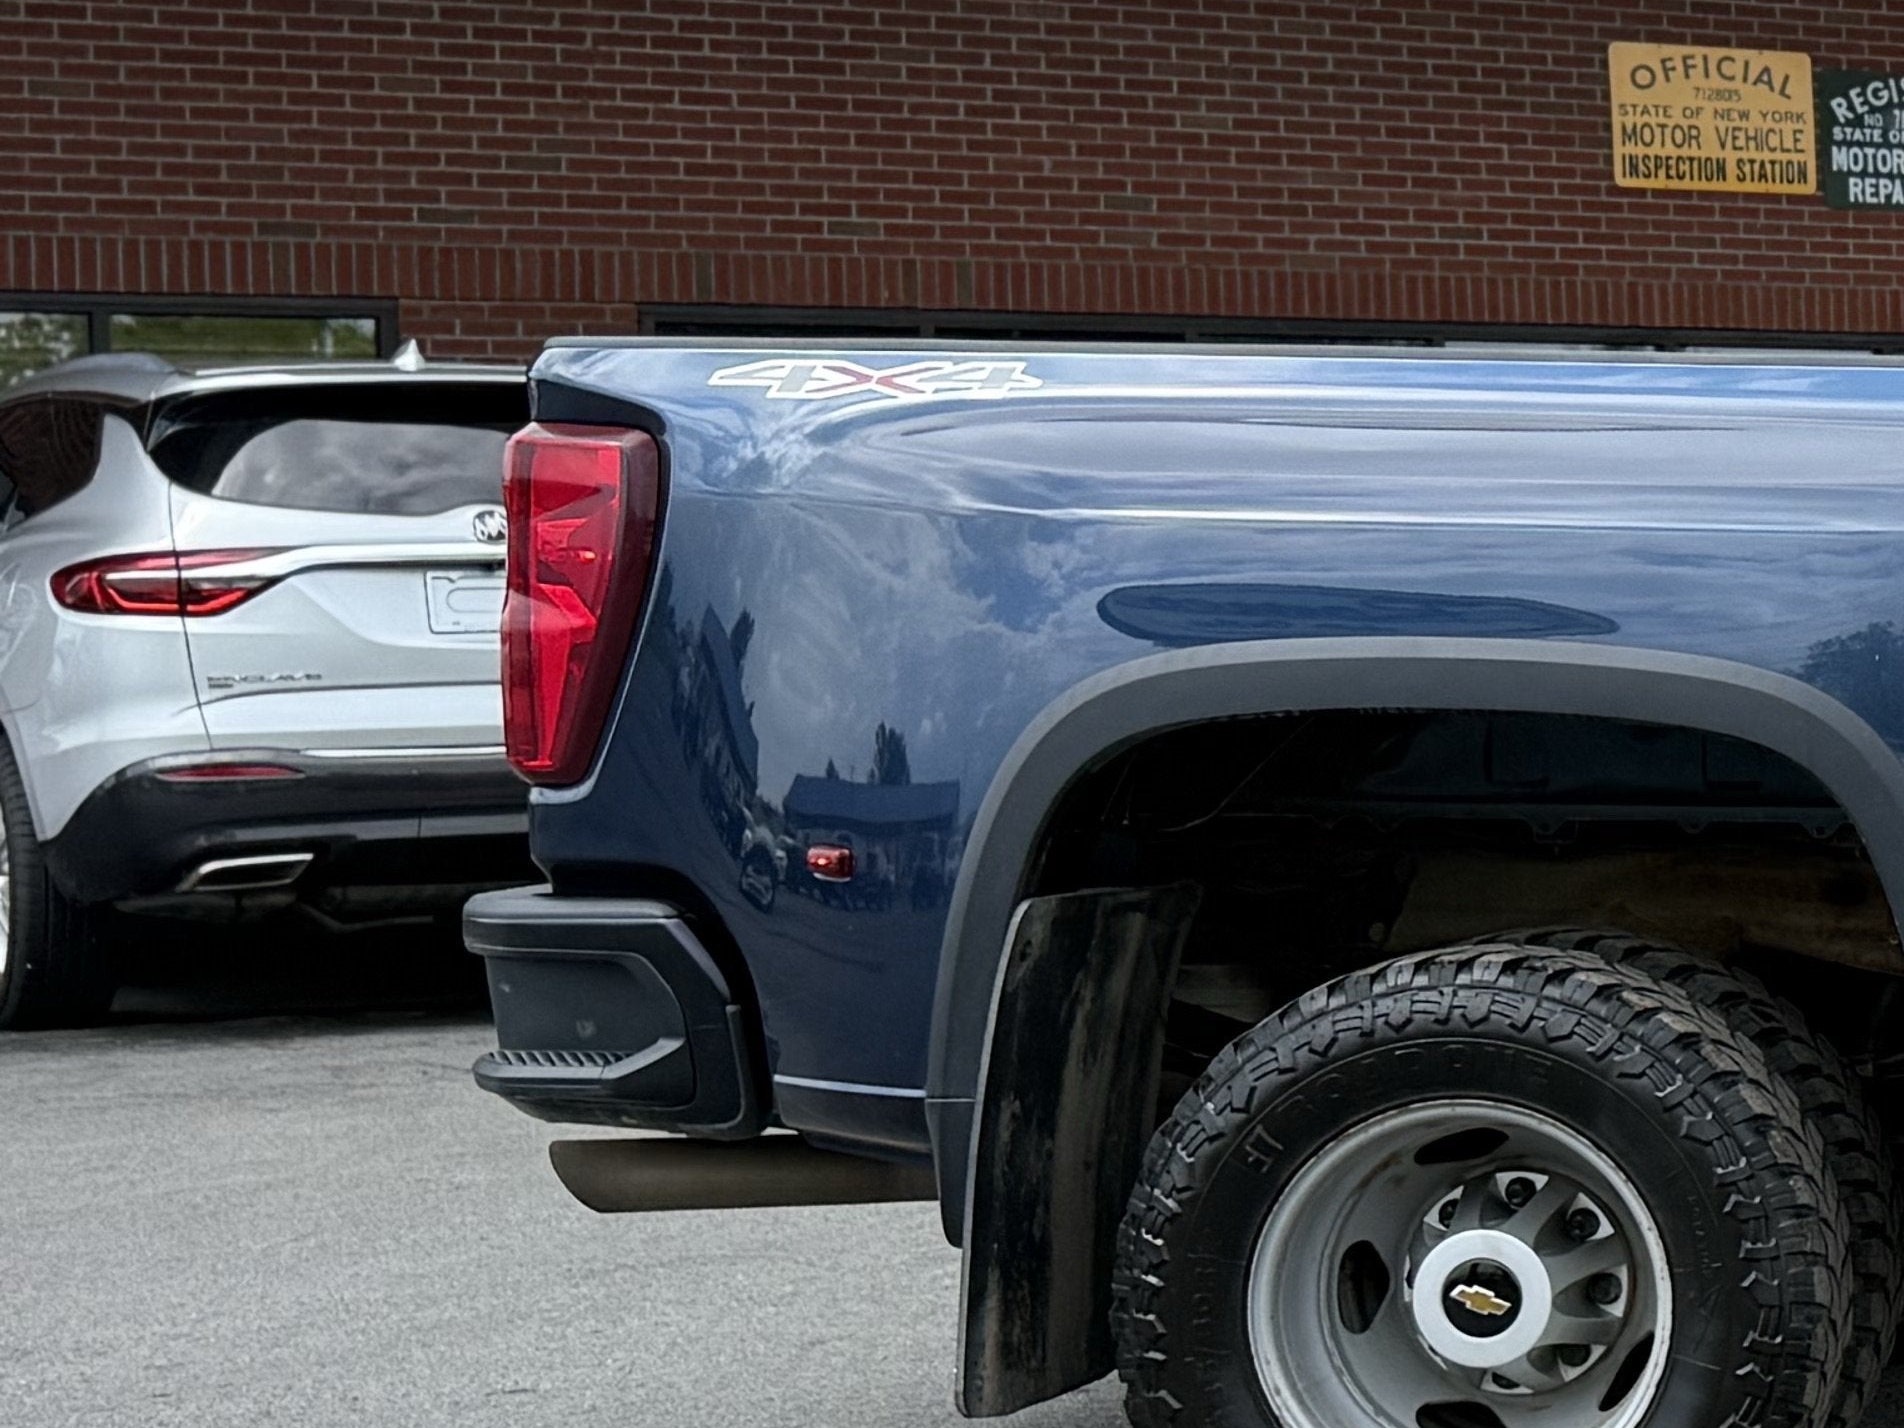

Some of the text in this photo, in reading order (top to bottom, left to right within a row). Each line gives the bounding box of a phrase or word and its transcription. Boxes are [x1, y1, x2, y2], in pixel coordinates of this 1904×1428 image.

[1630, 54, 1792, 100] OFFICIAL
[1618, 104, 1808, 125] STATE OF NEW YORK
[1621, 122, 1806, 154] MOTOR VEHICLE
[1832, 126, 1884, 143] STATE
[1621, 153, 1808, 185] INSPECTION STATION
